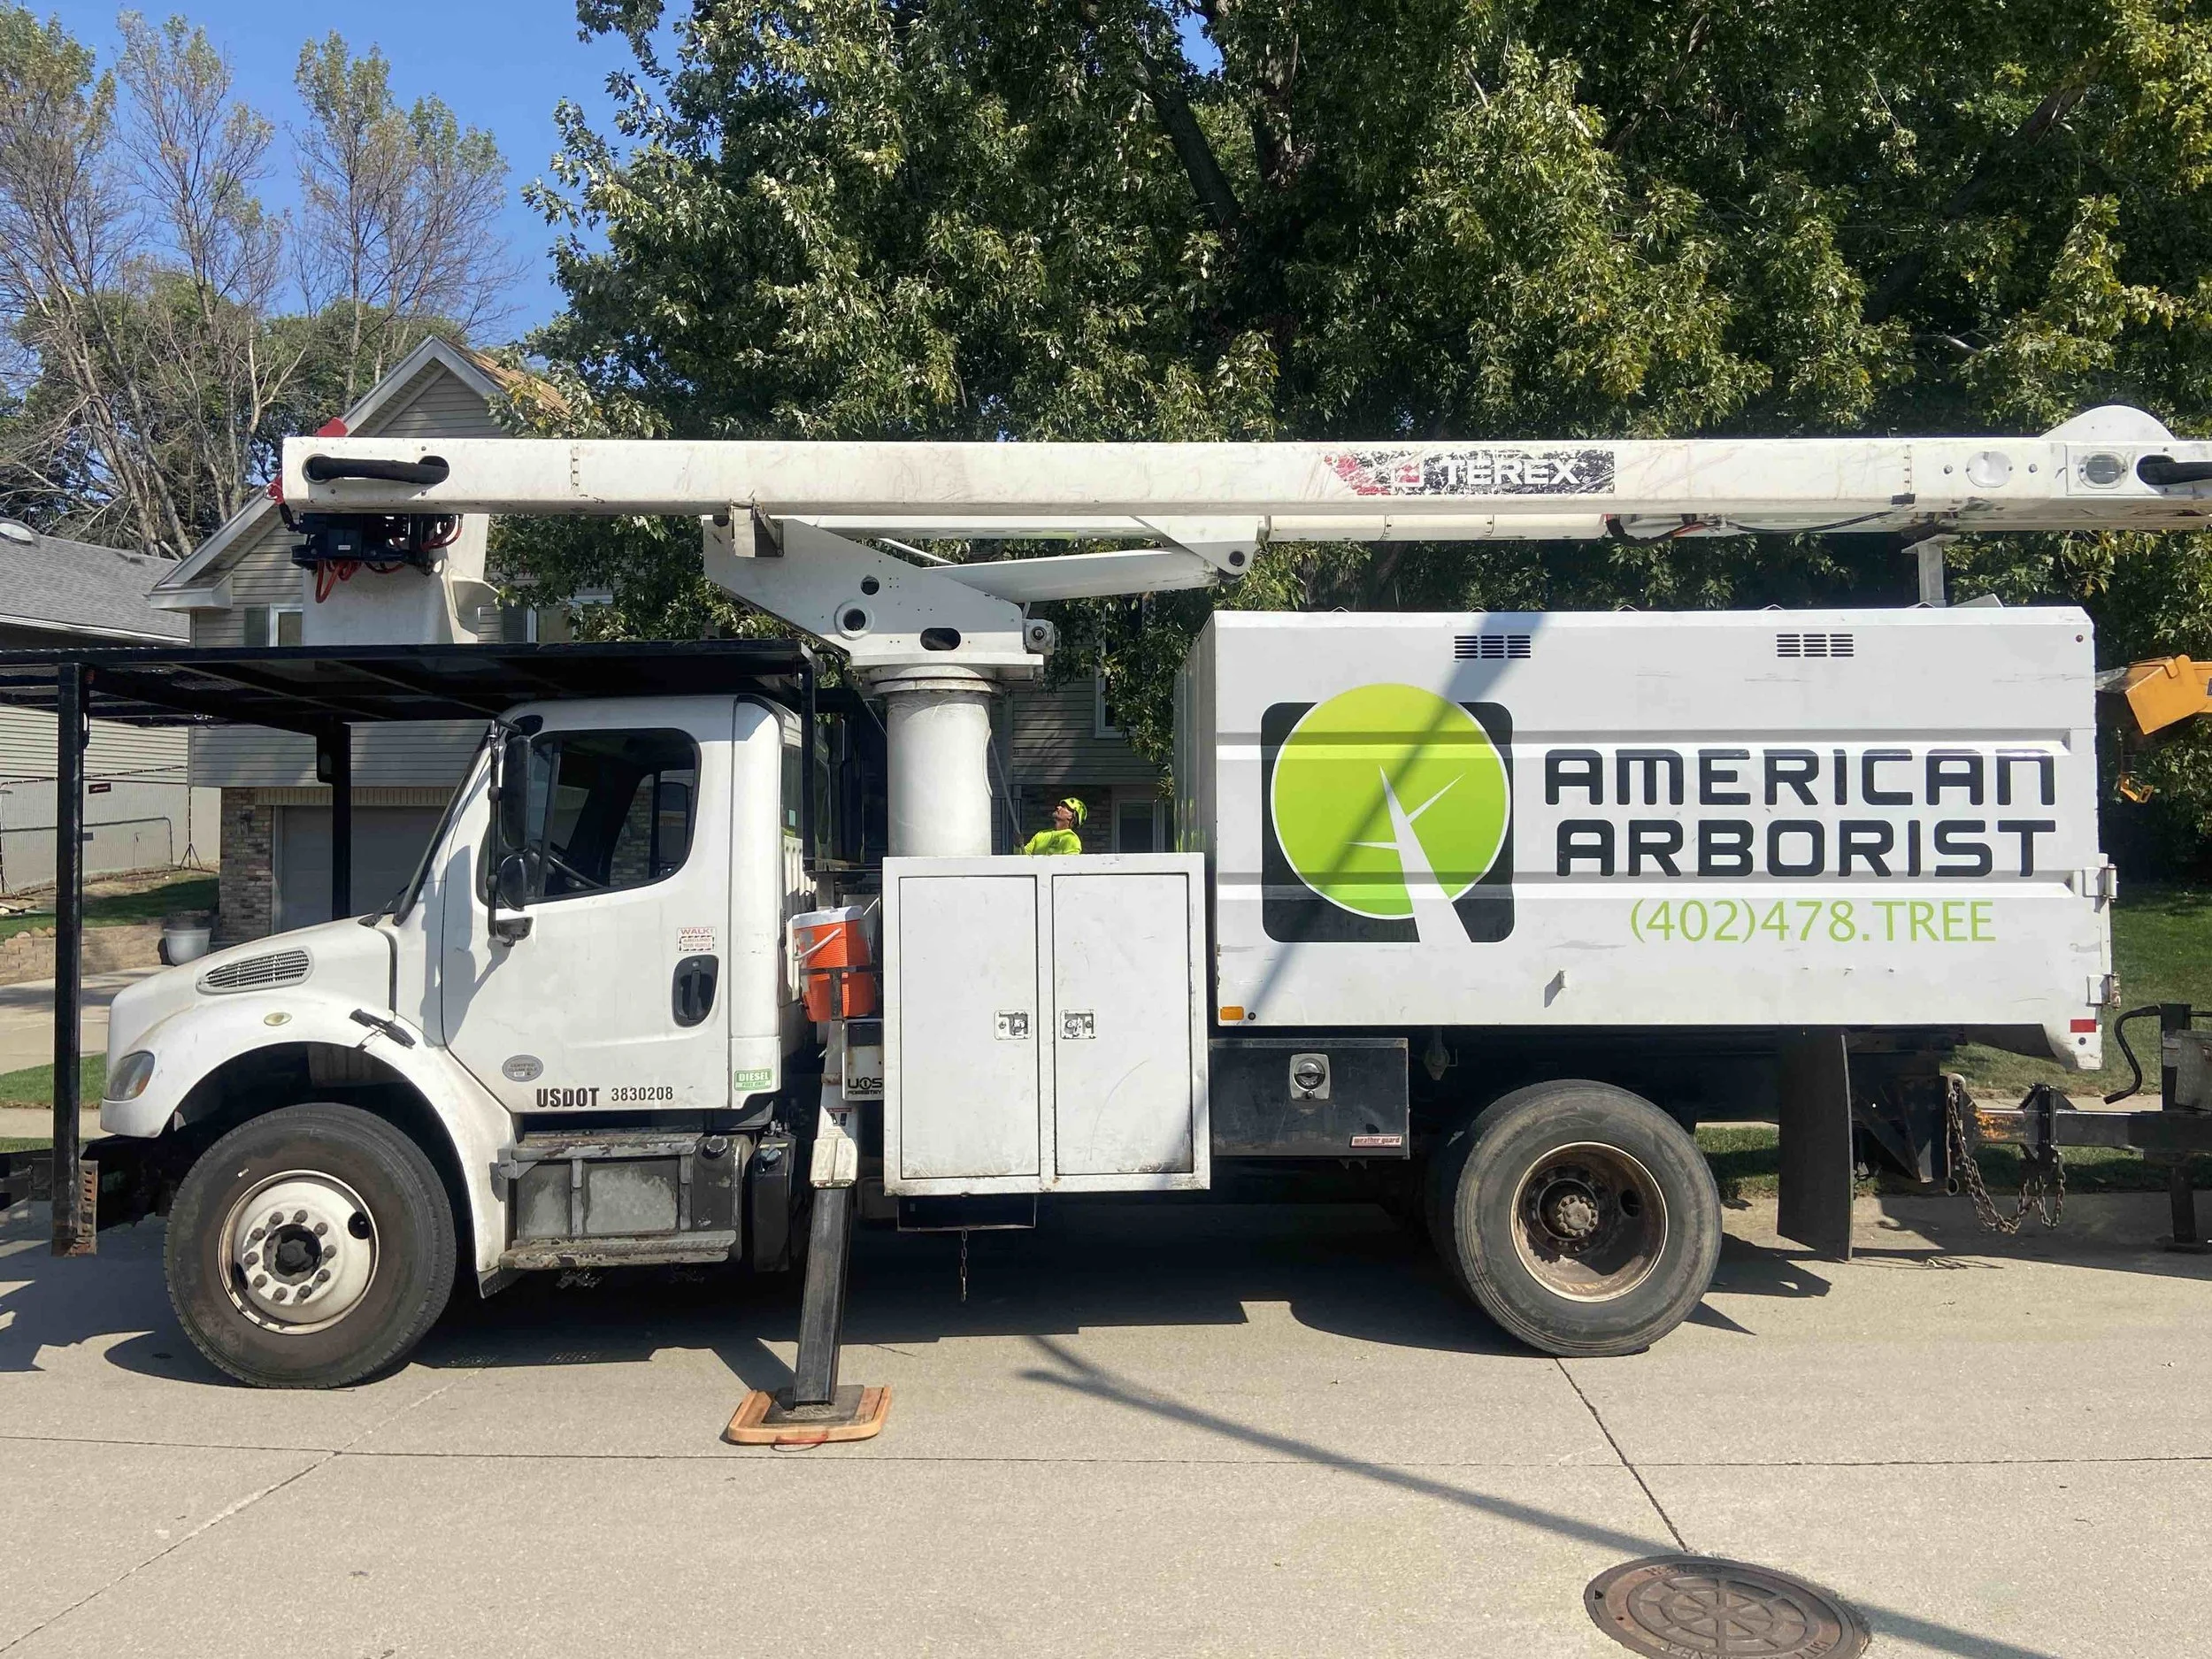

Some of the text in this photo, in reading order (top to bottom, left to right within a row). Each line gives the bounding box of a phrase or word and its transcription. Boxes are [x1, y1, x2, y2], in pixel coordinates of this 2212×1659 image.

[1440, 457, 1583, 486] TEREX
[1544, 749, 2055, 806] AMERICAN
[1556, 819, 2056, 877] ARBORIST
[1630, 898, 1996, 944] (402)478.TREE
[738, 1071, 769, 1082] DIESEL
[536, 1087, 673, 1108] USDOT 3830208
